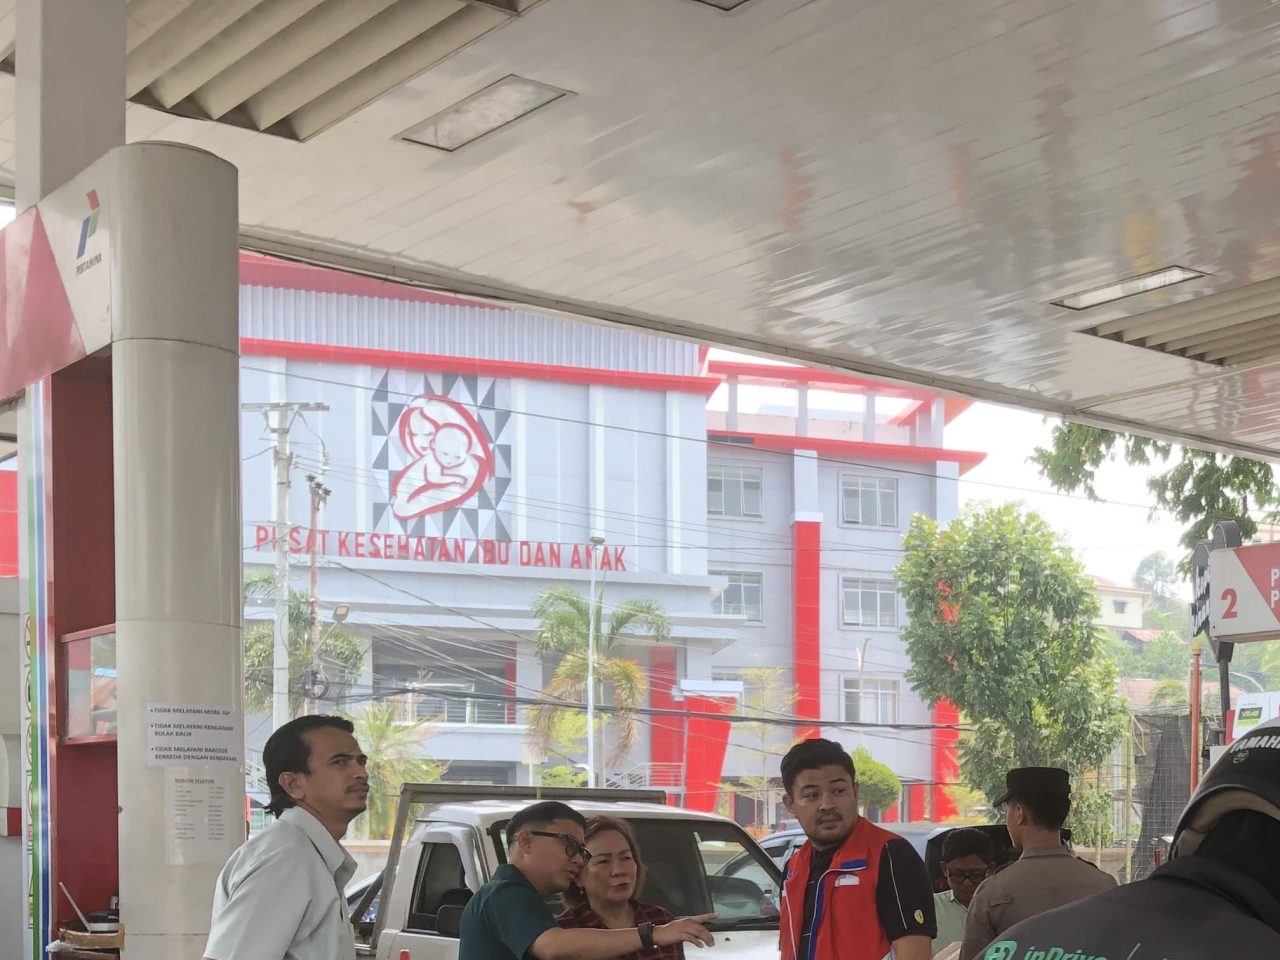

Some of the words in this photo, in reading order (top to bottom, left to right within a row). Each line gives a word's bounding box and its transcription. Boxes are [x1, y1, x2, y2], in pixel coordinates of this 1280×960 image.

[338, 531, 467, 563] KESEHATAN
[475, 540, 510, 565] IBU
[519, 540, 561, 568] DAN
[1221, 588, 1238, 619] 2
